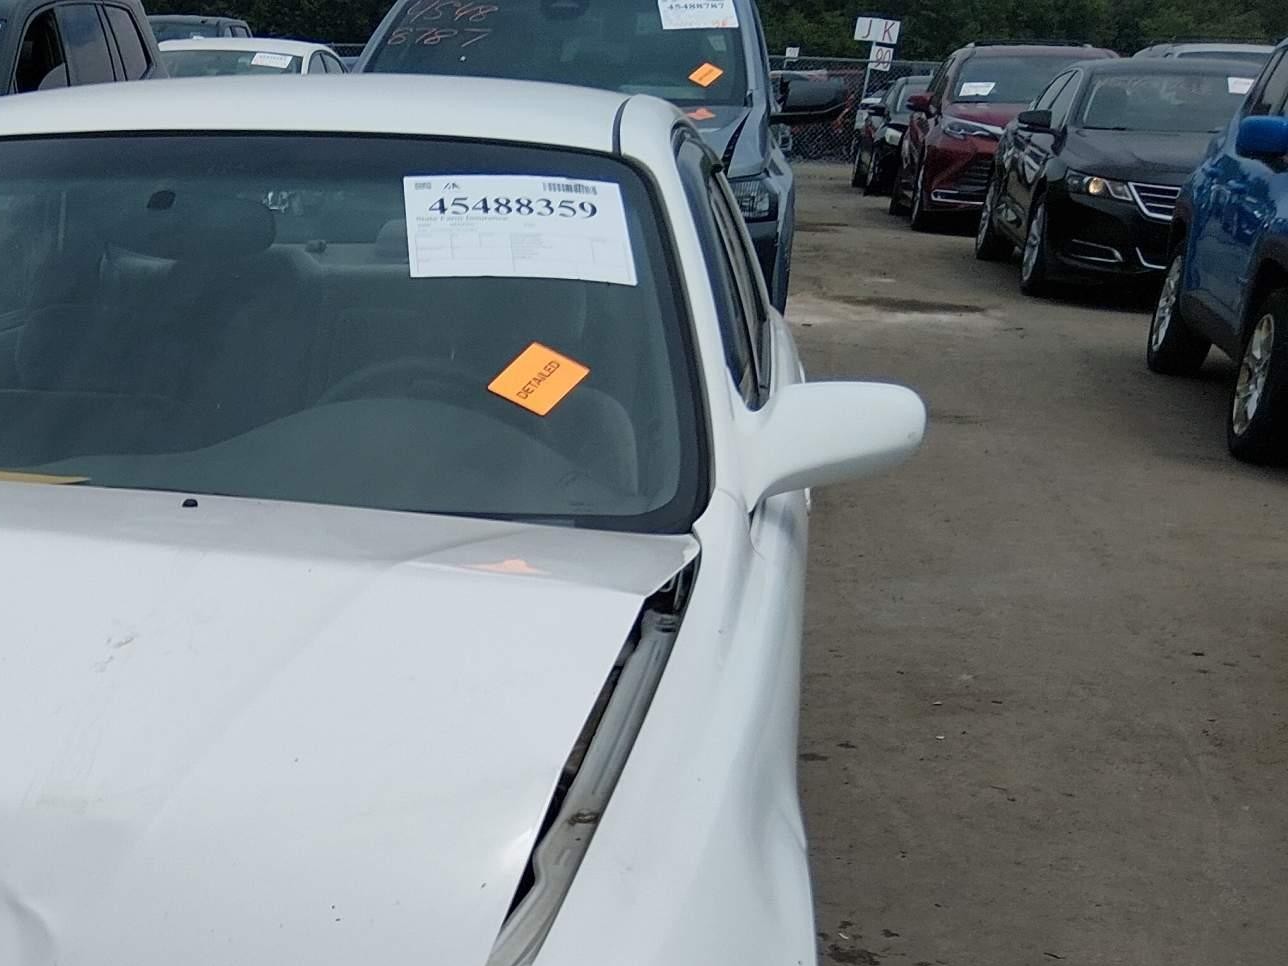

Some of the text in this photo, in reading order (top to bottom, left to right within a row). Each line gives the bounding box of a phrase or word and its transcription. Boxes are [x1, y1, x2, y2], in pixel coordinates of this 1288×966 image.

[861, 19, 896, 42] J K
[874, 47, 892, 70] 90
[428, 195, 599, 220] 45488359
[516, 360, 561, 400] DETAILED
